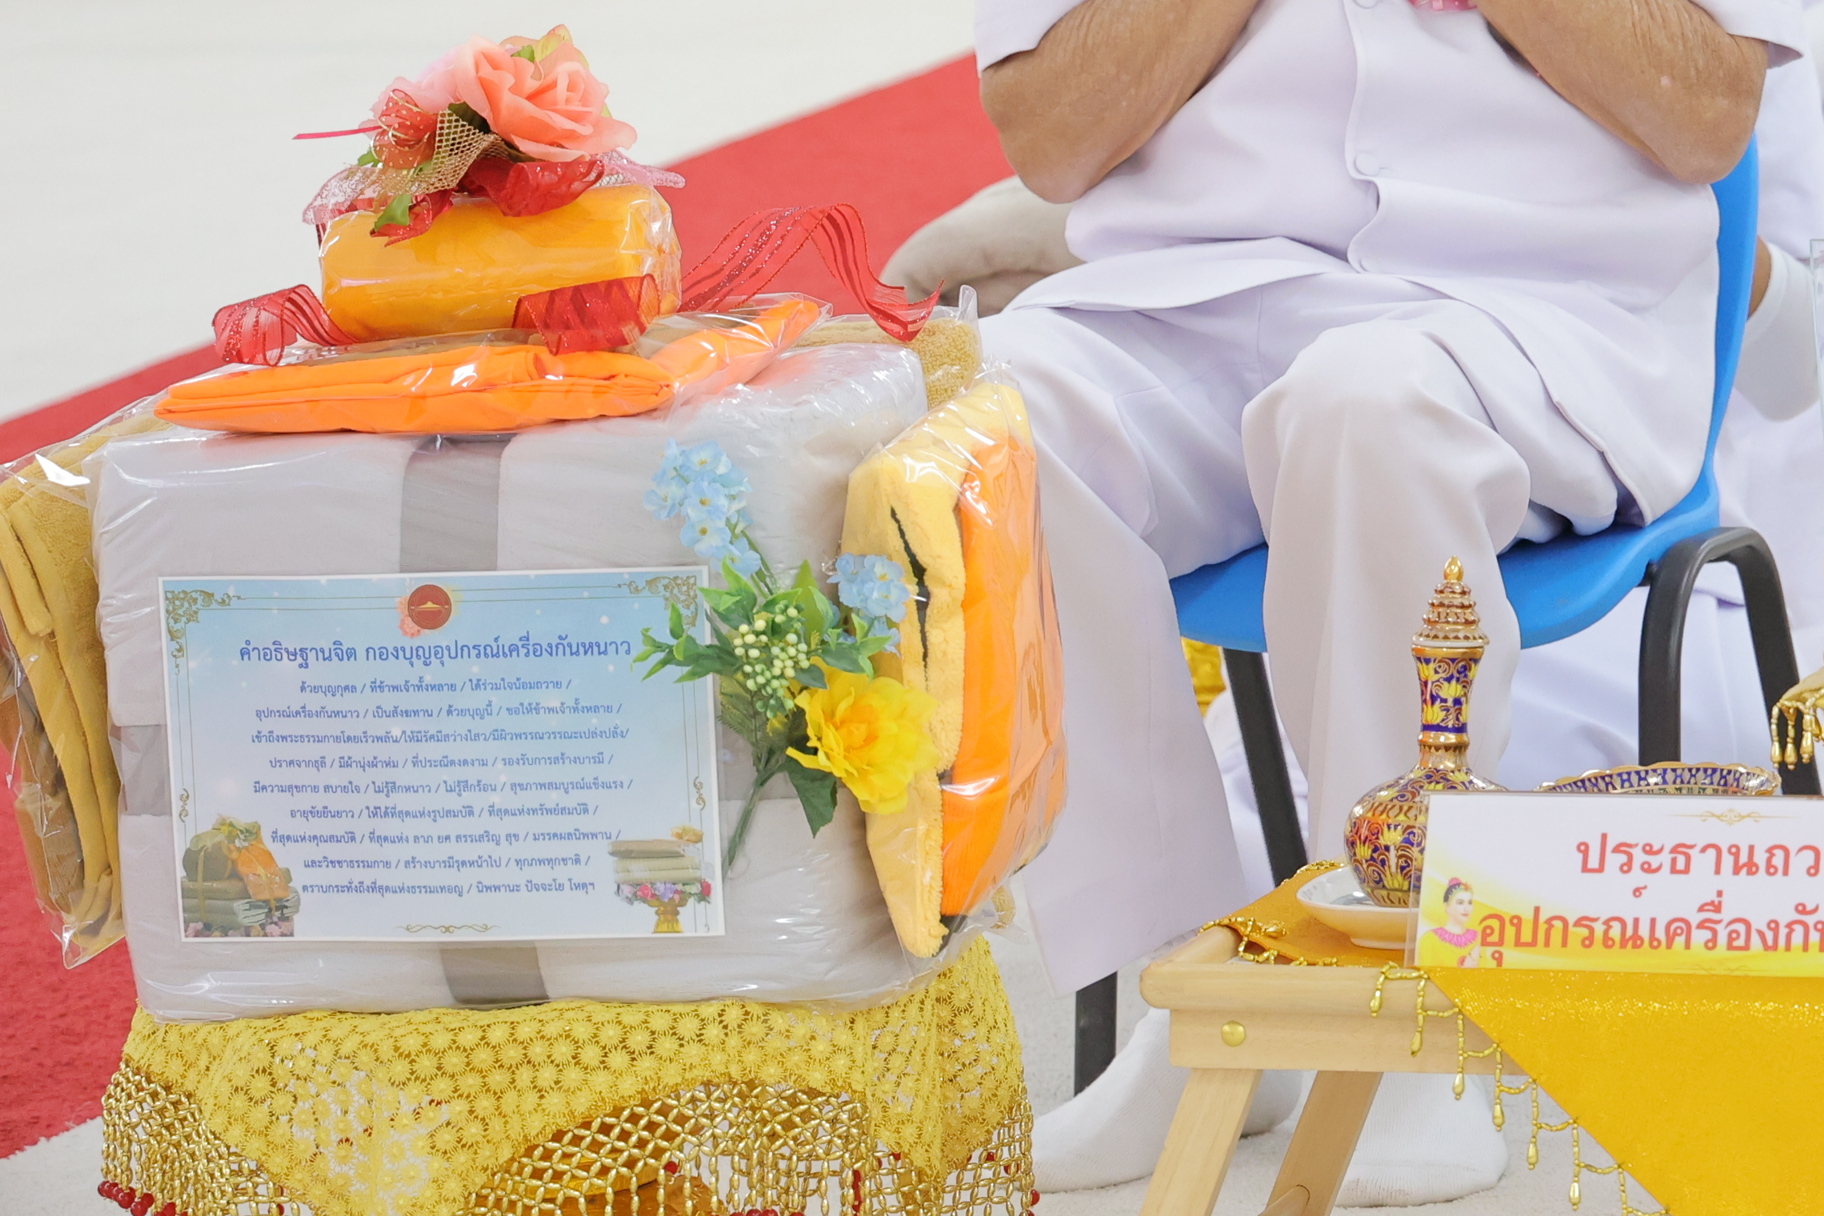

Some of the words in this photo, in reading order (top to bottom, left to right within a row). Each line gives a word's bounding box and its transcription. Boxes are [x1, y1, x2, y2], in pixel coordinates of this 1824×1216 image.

[239, 639, 358, 669] คำอธิษฐานจิต
[364, 630, 632, 667] กองบุญอุปกรณ์เครื่องกันหนาว
